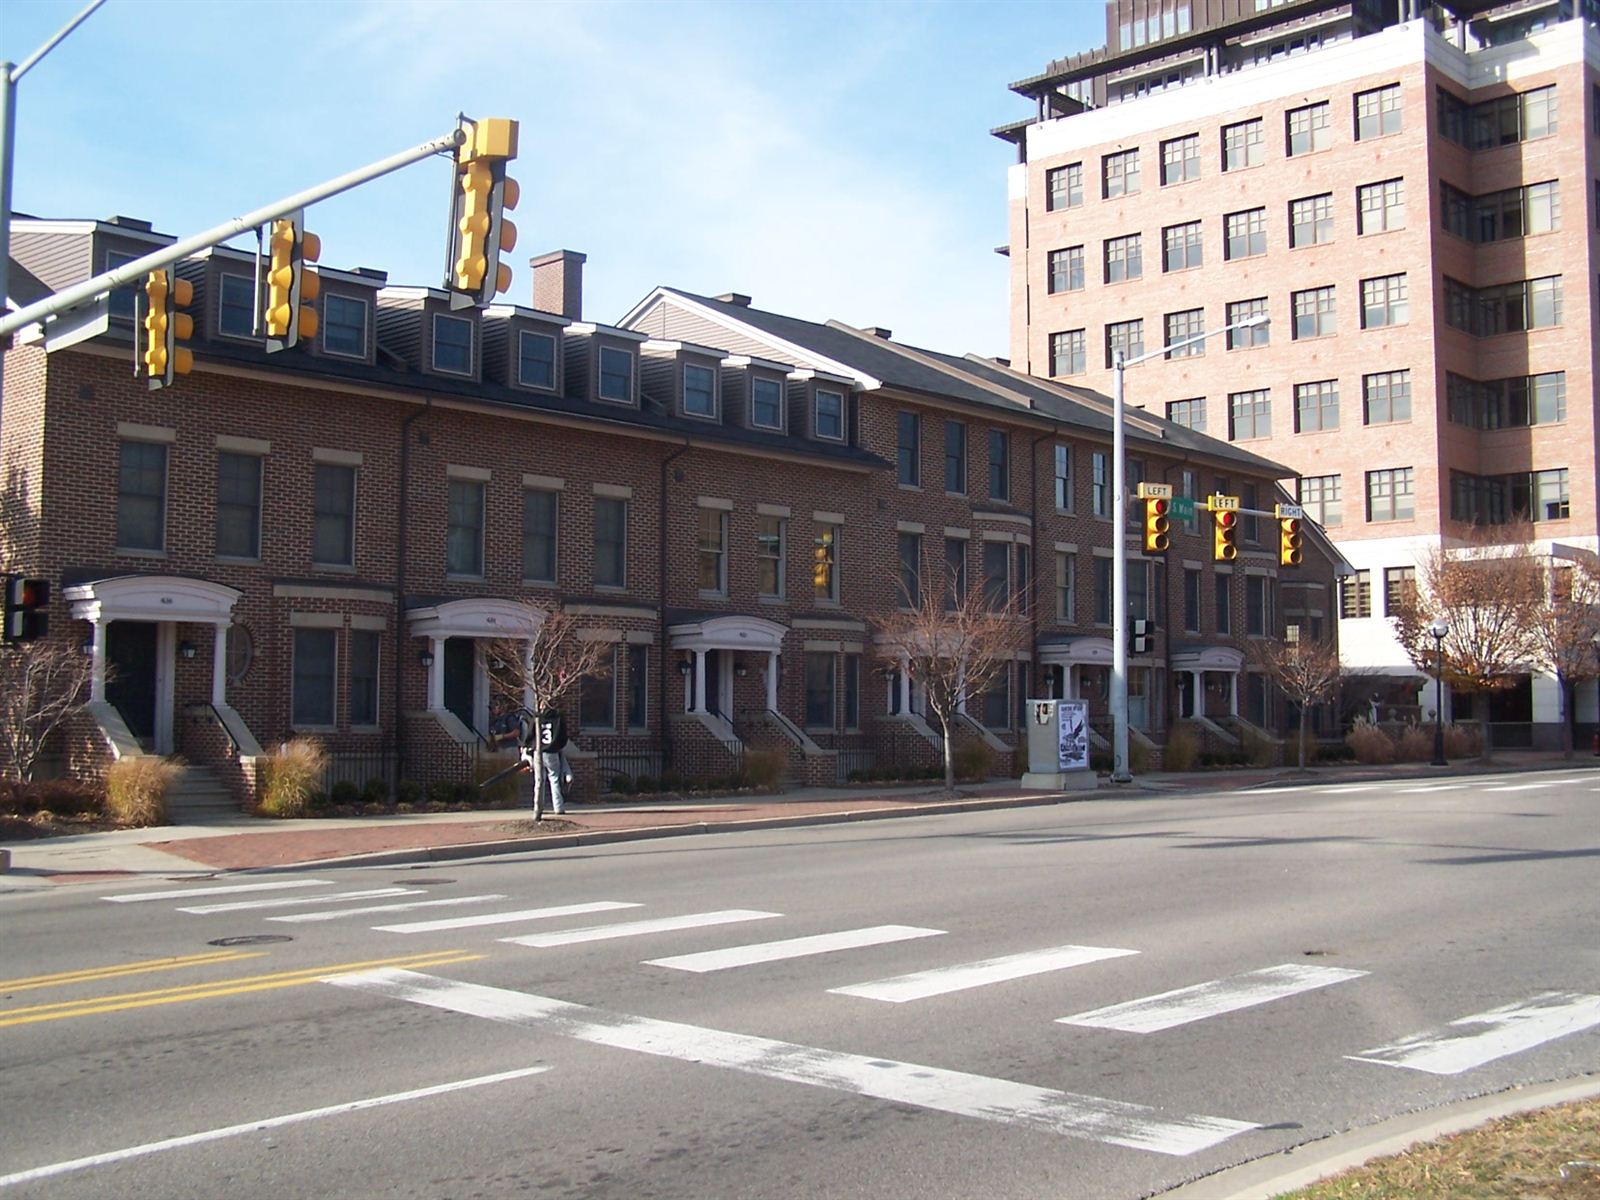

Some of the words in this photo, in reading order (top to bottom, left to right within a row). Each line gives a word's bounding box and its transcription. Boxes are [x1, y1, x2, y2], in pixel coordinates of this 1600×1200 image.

[1147, 487, 1167, 496] LEFT
[1172, 502, 1177, 513] S
[1214, 499, 1235, 508] LEFT
[1280, 507, 1301, 517] RIGHT
[541, 729, 552, 744] 3
